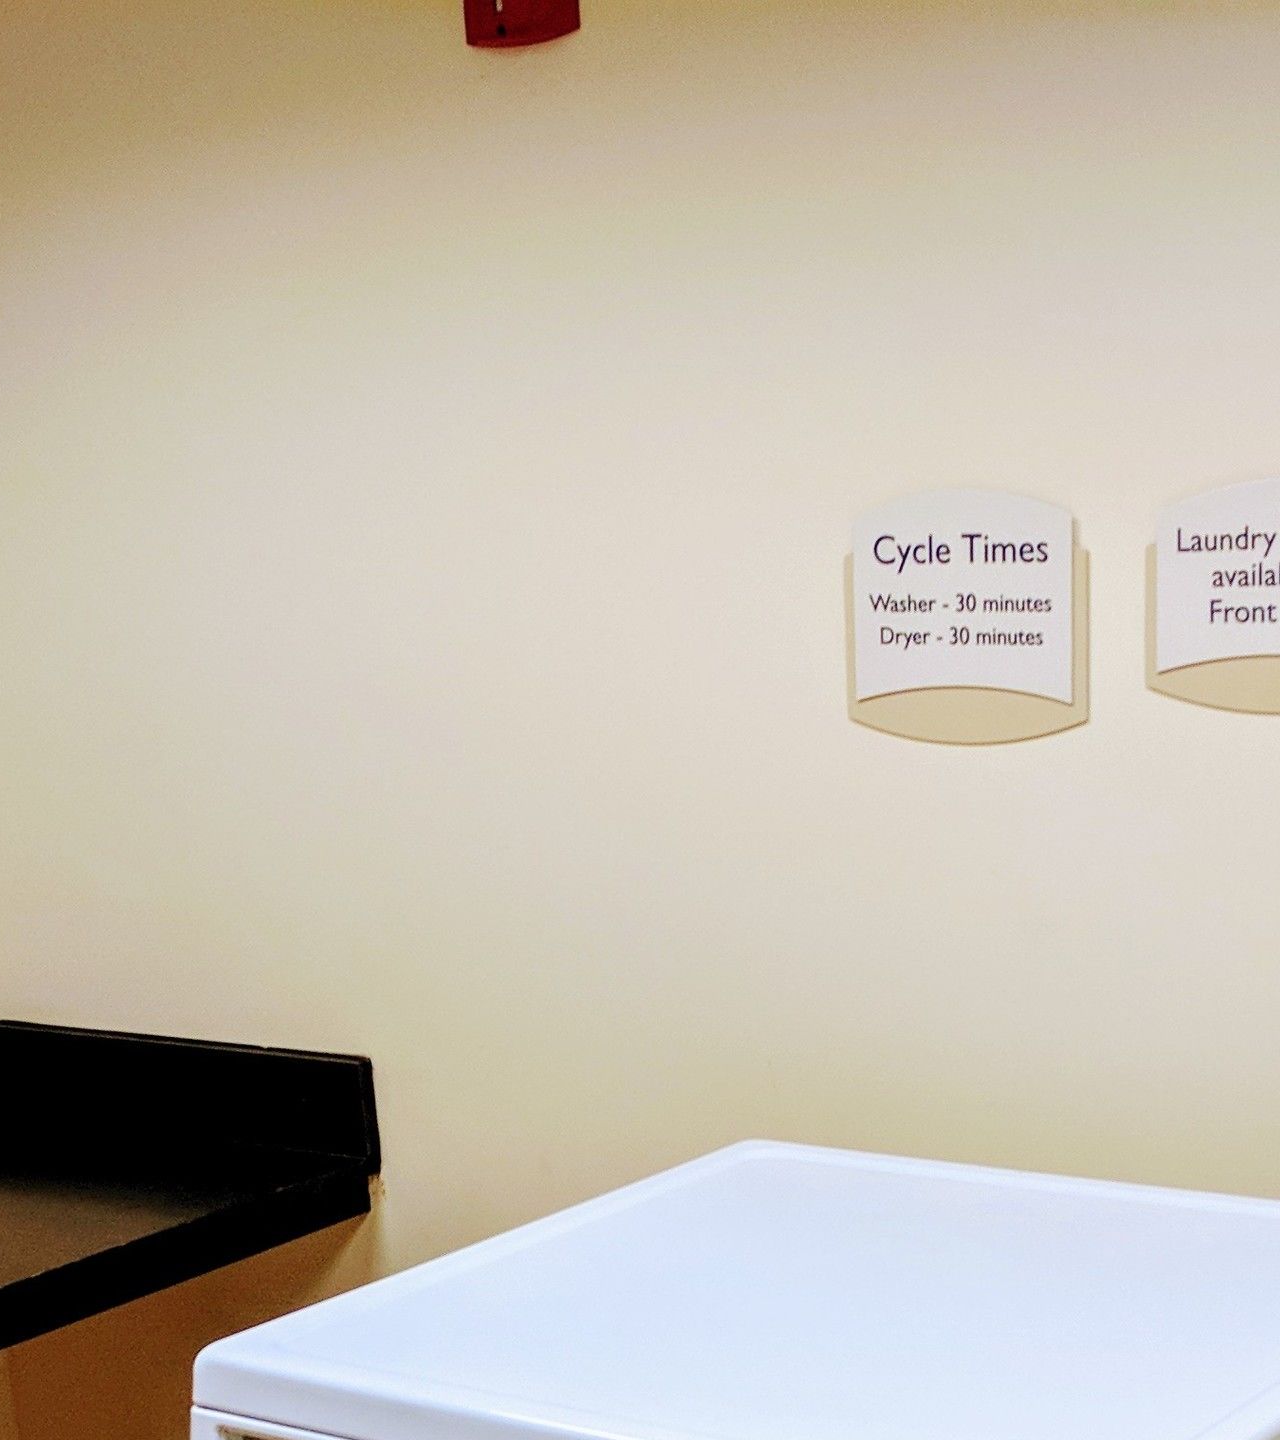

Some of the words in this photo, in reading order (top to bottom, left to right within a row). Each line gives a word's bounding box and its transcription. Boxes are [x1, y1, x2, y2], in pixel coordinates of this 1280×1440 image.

[873, 533, 951, 575] Cycle
[961, 532, 1049, 563] Times
[1176, 525, 1277, 557] Laundry
[869, 593, 936, 612] Washer
[955, 593, 977, 612] 30
[983, 593, 1052, 613] minutes
[1209, 599, 1278, 624] Front
[880, 626, 931, 650] Dryer
[949, 626, 970, 645] 30
[976, 627, 1044, 646] minutes
